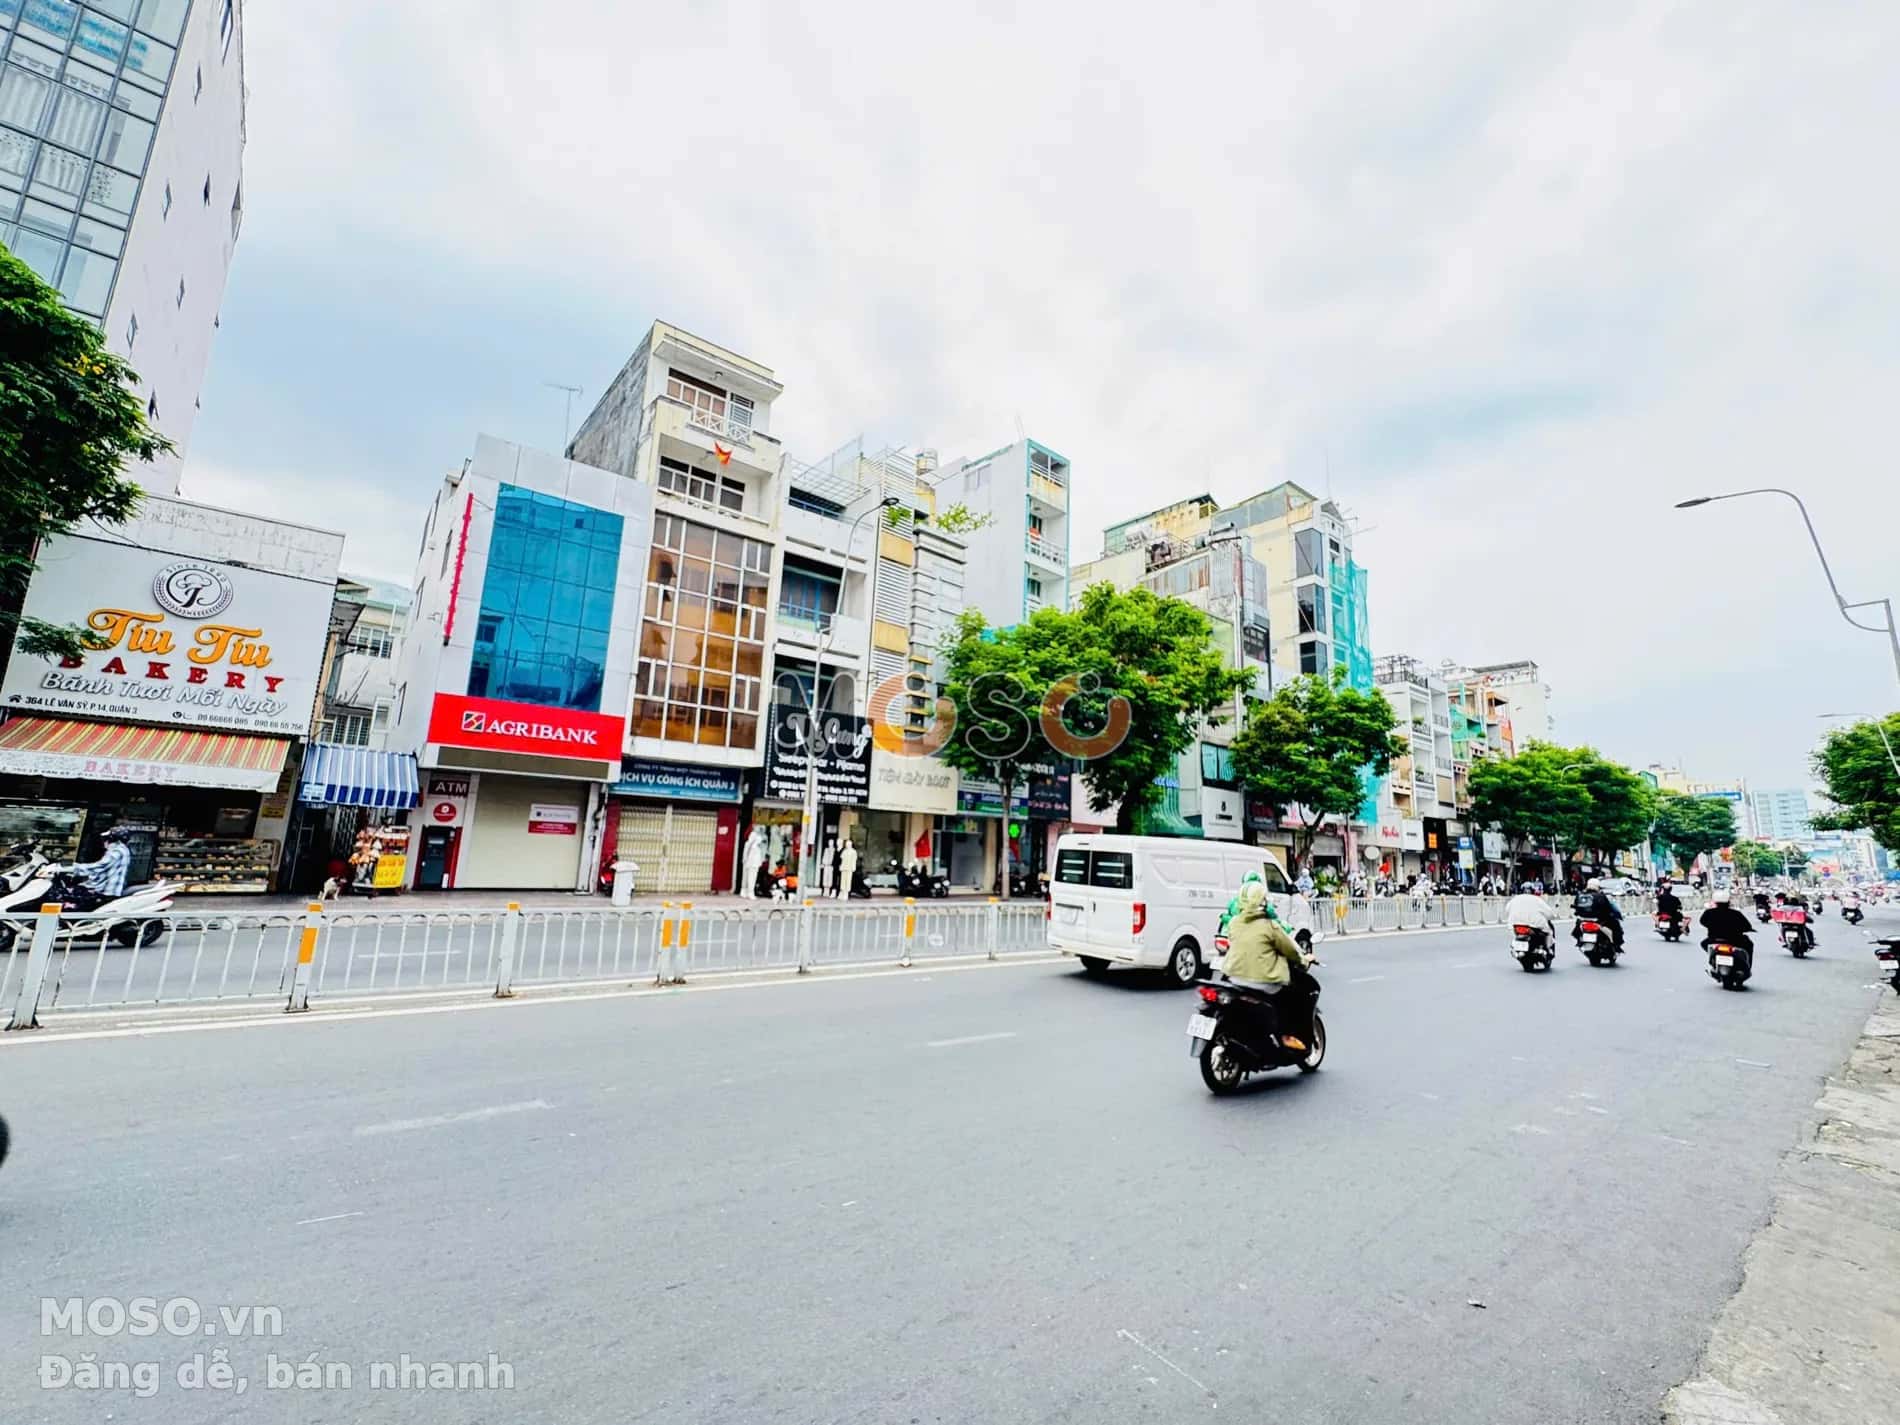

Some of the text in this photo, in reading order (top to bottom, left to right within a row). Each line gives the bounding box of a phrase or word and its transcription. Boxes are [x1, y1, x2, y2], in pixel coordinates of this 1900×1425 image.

[59, 654, 284, 693] BAKERY
[41, 670, 113, 695] Bánh
[119, 679, 174, 700] Tươi
[227, 692, 289, 716] Ngày
[486, 718, 598, 746] AGRIBANK
[435, 781, 468, 794] ATM
[656, 773, 683, 787] CÔNG
